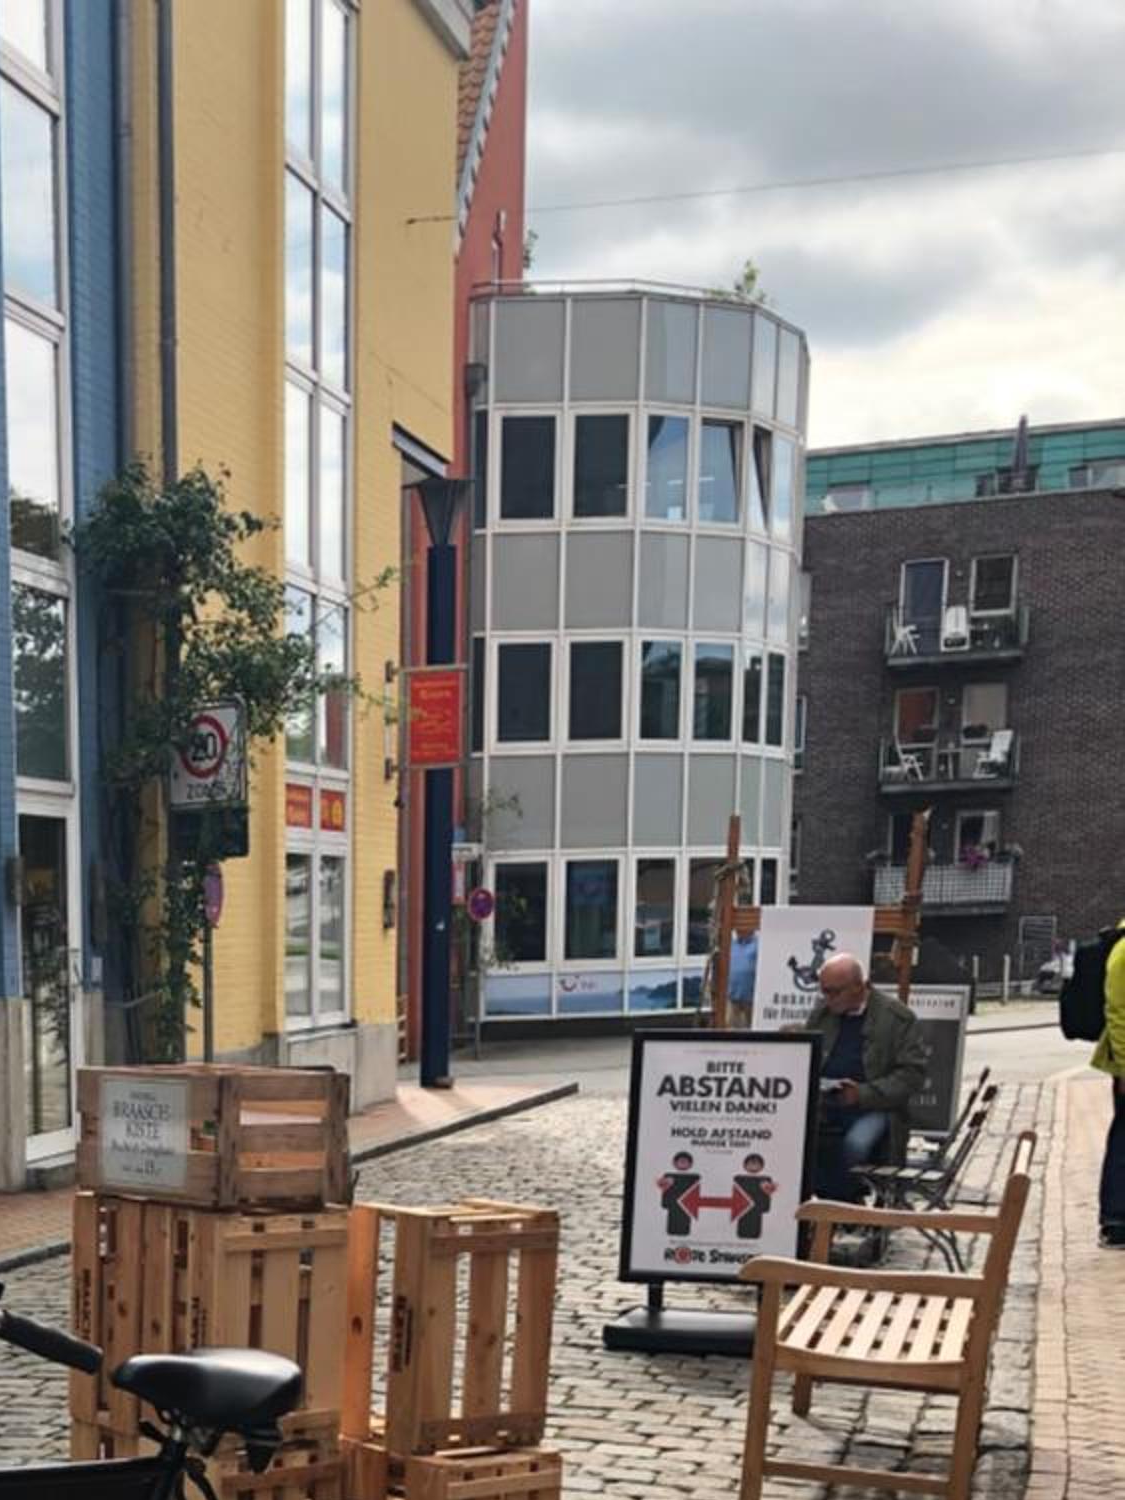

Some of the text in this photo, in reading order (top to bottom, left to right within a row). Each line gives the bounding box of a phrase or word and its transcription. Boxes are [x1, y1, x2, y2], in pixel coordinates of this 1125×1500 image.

[706, 1060, 745, 1074] BITTE
[657, 1074, 792, 1099] ABSTAND
[670, 1100, 777, 1115] VIELEN DANK!
[670, 1126, 773, 1141] HOLD AFSTAND
